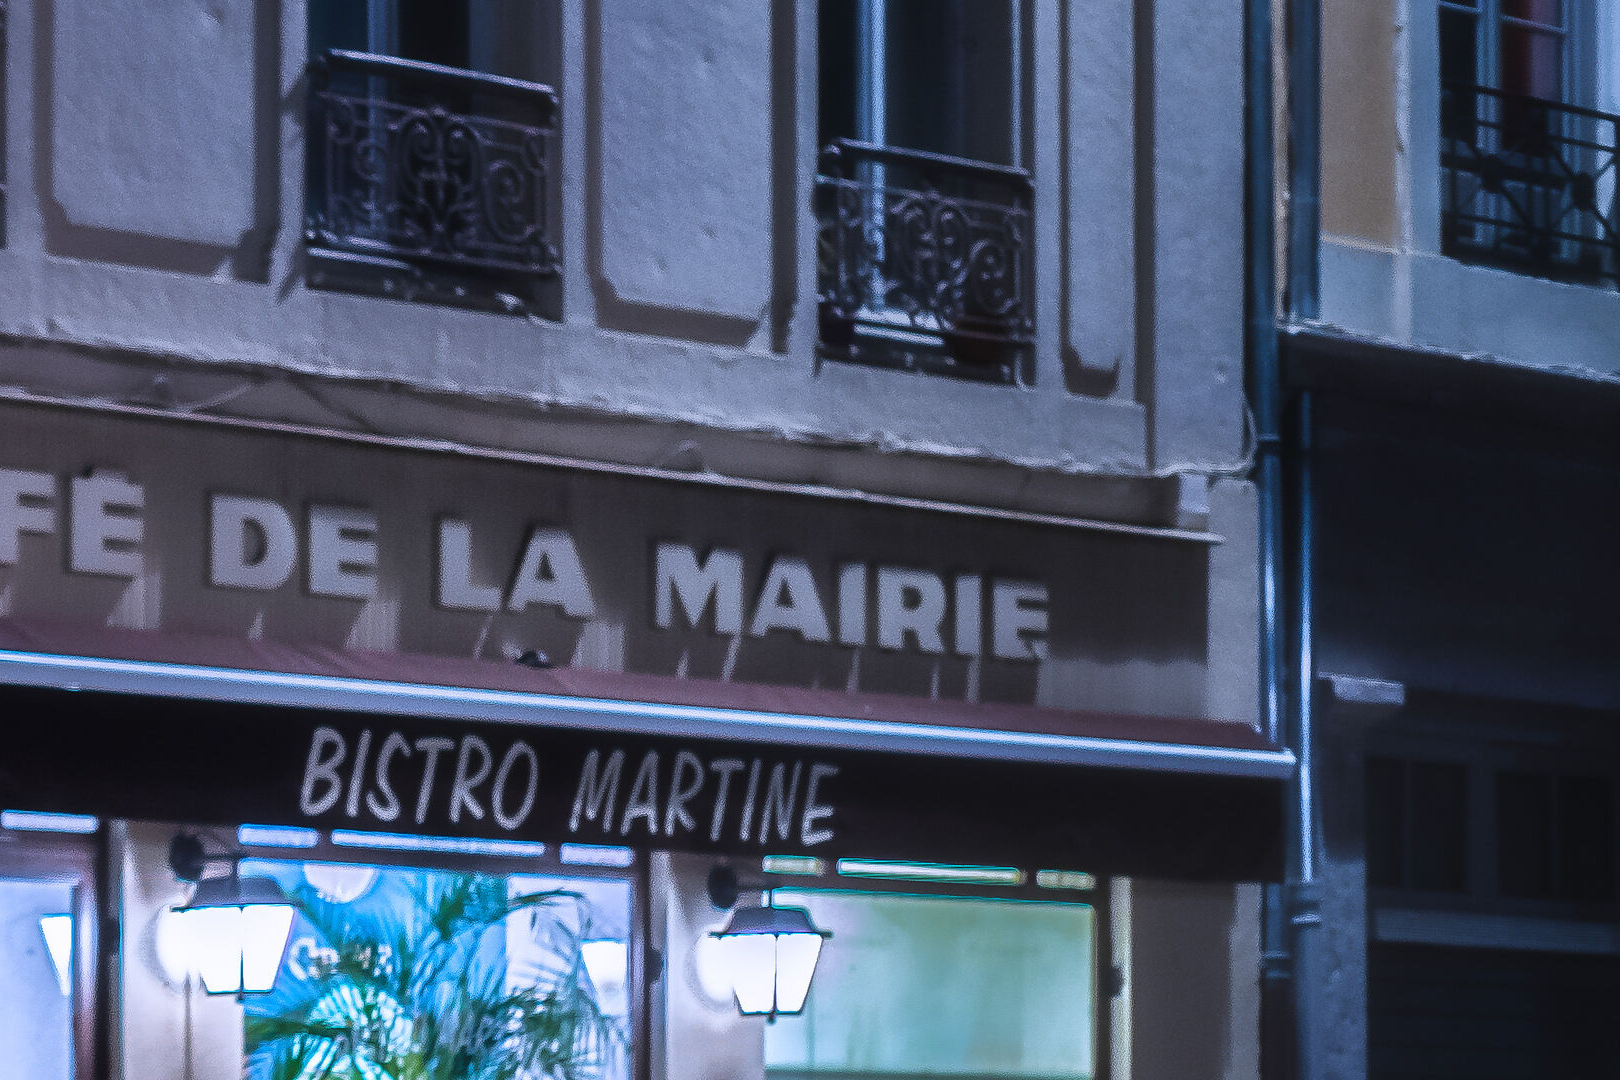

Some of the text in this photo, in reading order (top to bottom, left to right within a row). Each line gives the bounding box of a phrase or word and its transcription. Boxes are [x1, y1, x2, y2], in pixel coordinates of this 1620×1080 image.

[209, 493, 379, 600] DE
[438, 518, 596, 616] LA
[655, 542, 1049, 660] MAIRIE
[299, 726, 840, 846] BISTRO MARTINE
